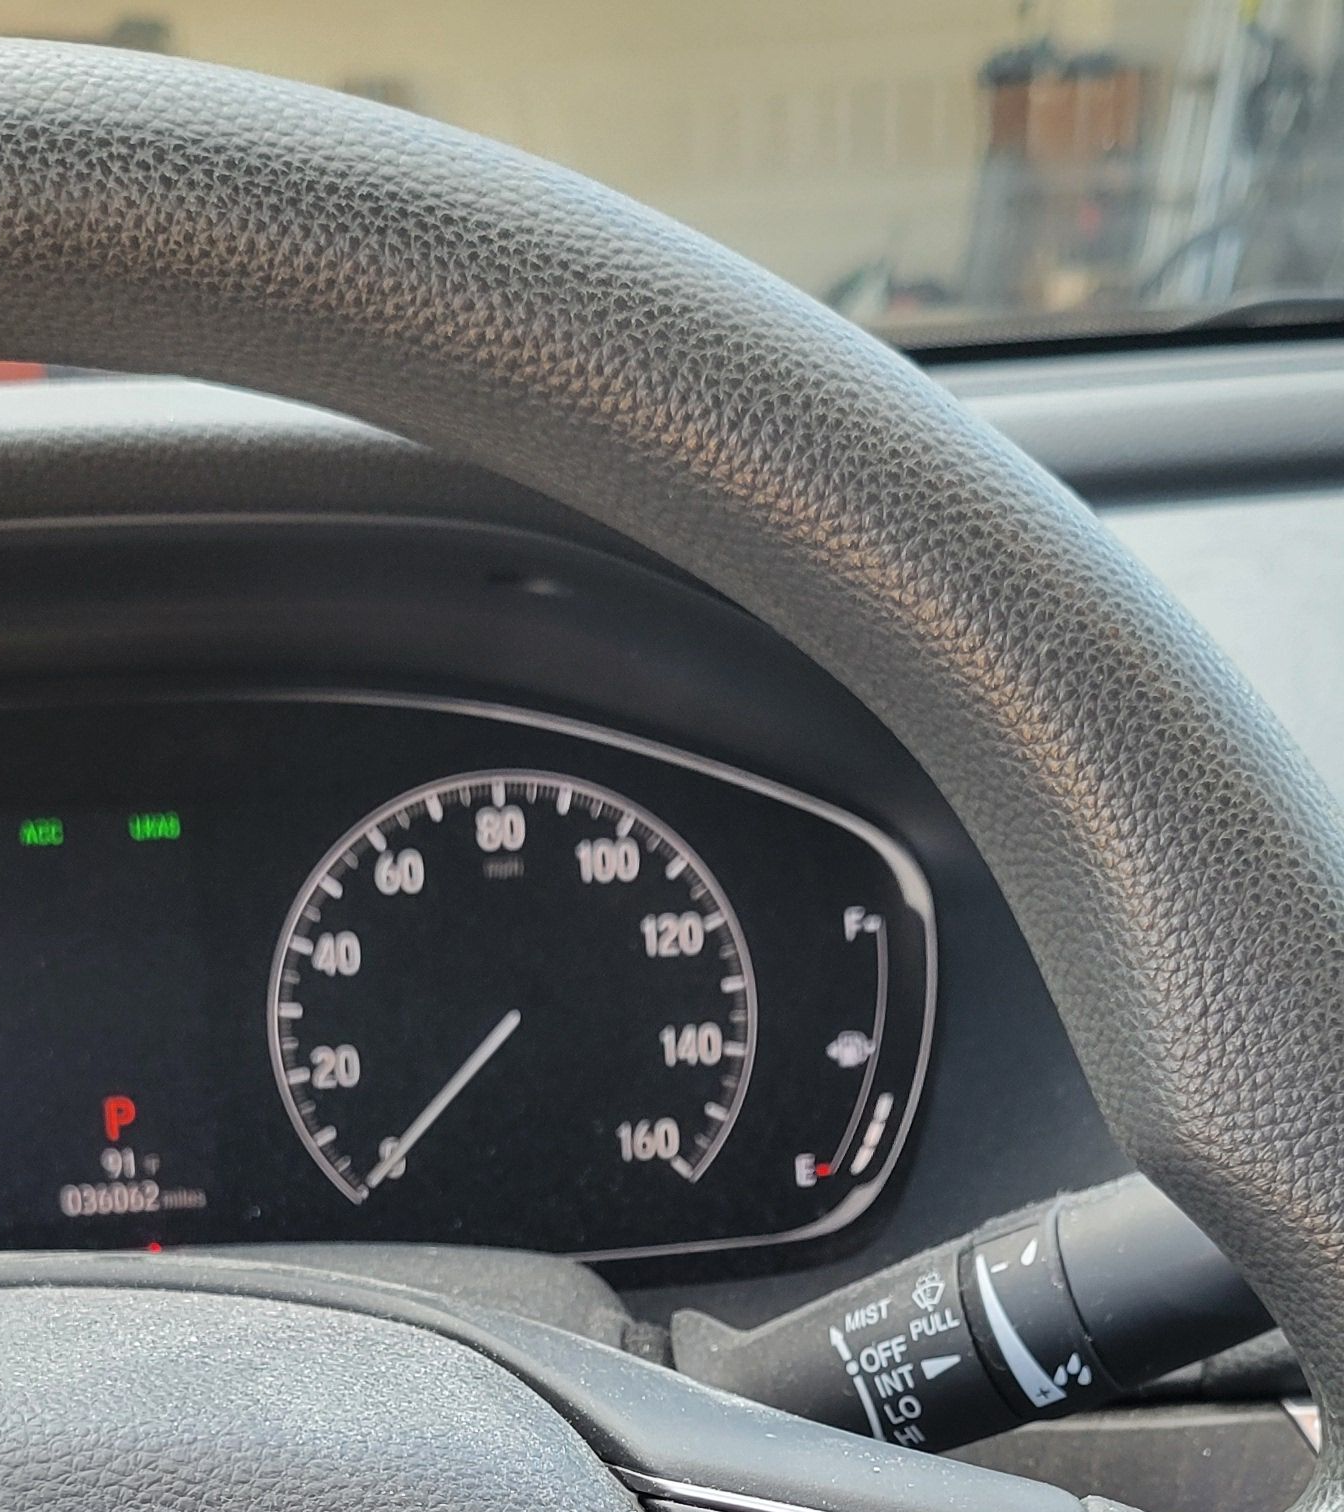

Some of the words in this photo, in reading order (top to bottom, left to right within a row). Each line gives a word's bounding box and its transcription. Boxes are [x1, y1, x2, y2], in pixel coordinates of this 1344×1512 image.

[476, 805, 525, 851] 80
[375, 849, 425, 894] 60
[575, 837, 640, 883] 100
[312, 932, 361, 976] 40
[641, 912, 704, 957] 120
[660, 1022, 722, 1066] 140
[311, 1045, 360, 1088] 20
[104, 1096, 137, 1141] P
[616, 1119, 679, 1160] 160
[845, 1297, 894, 1333] MIST
[909, 1307, 960, 1342] PULL
[860, 1335, 907, 1373] OFF
[874, 1363, 915, 1398] INT
[884, 1395, 922, 1425] LO
